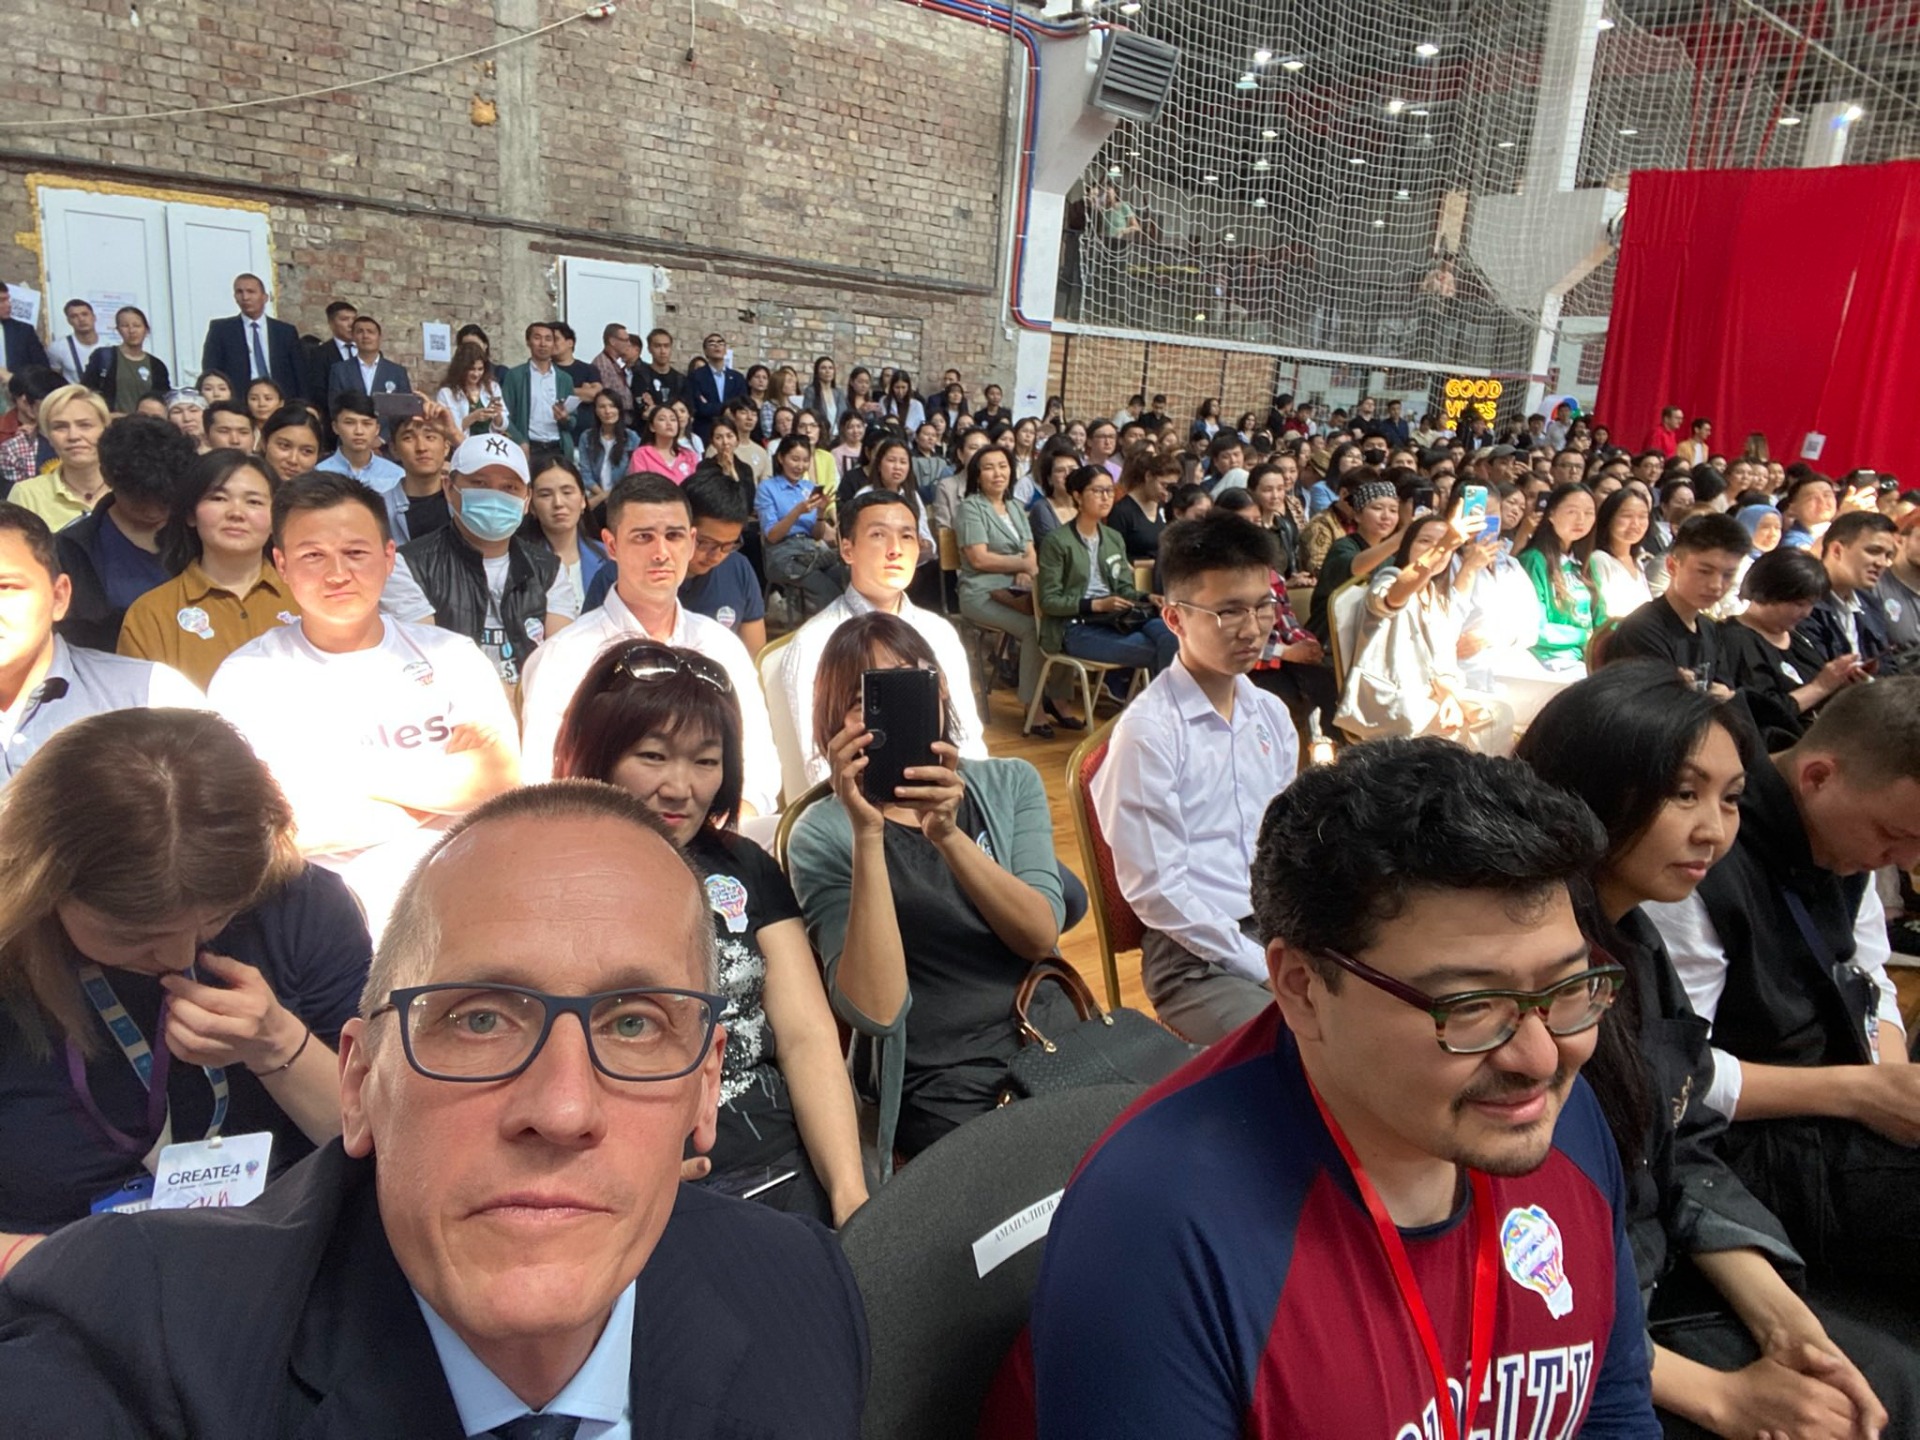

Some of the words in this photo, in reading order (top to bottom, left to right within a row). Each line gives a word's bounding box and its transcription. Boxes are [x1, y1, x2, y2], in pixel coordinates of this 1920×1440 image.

[1446, 379, 1503, 399] GOOD
[1446, 400, 1497, 420] VIES
[485, 437, 509, 457] NY
[167, 1163, 241, 1187] CREATE4
